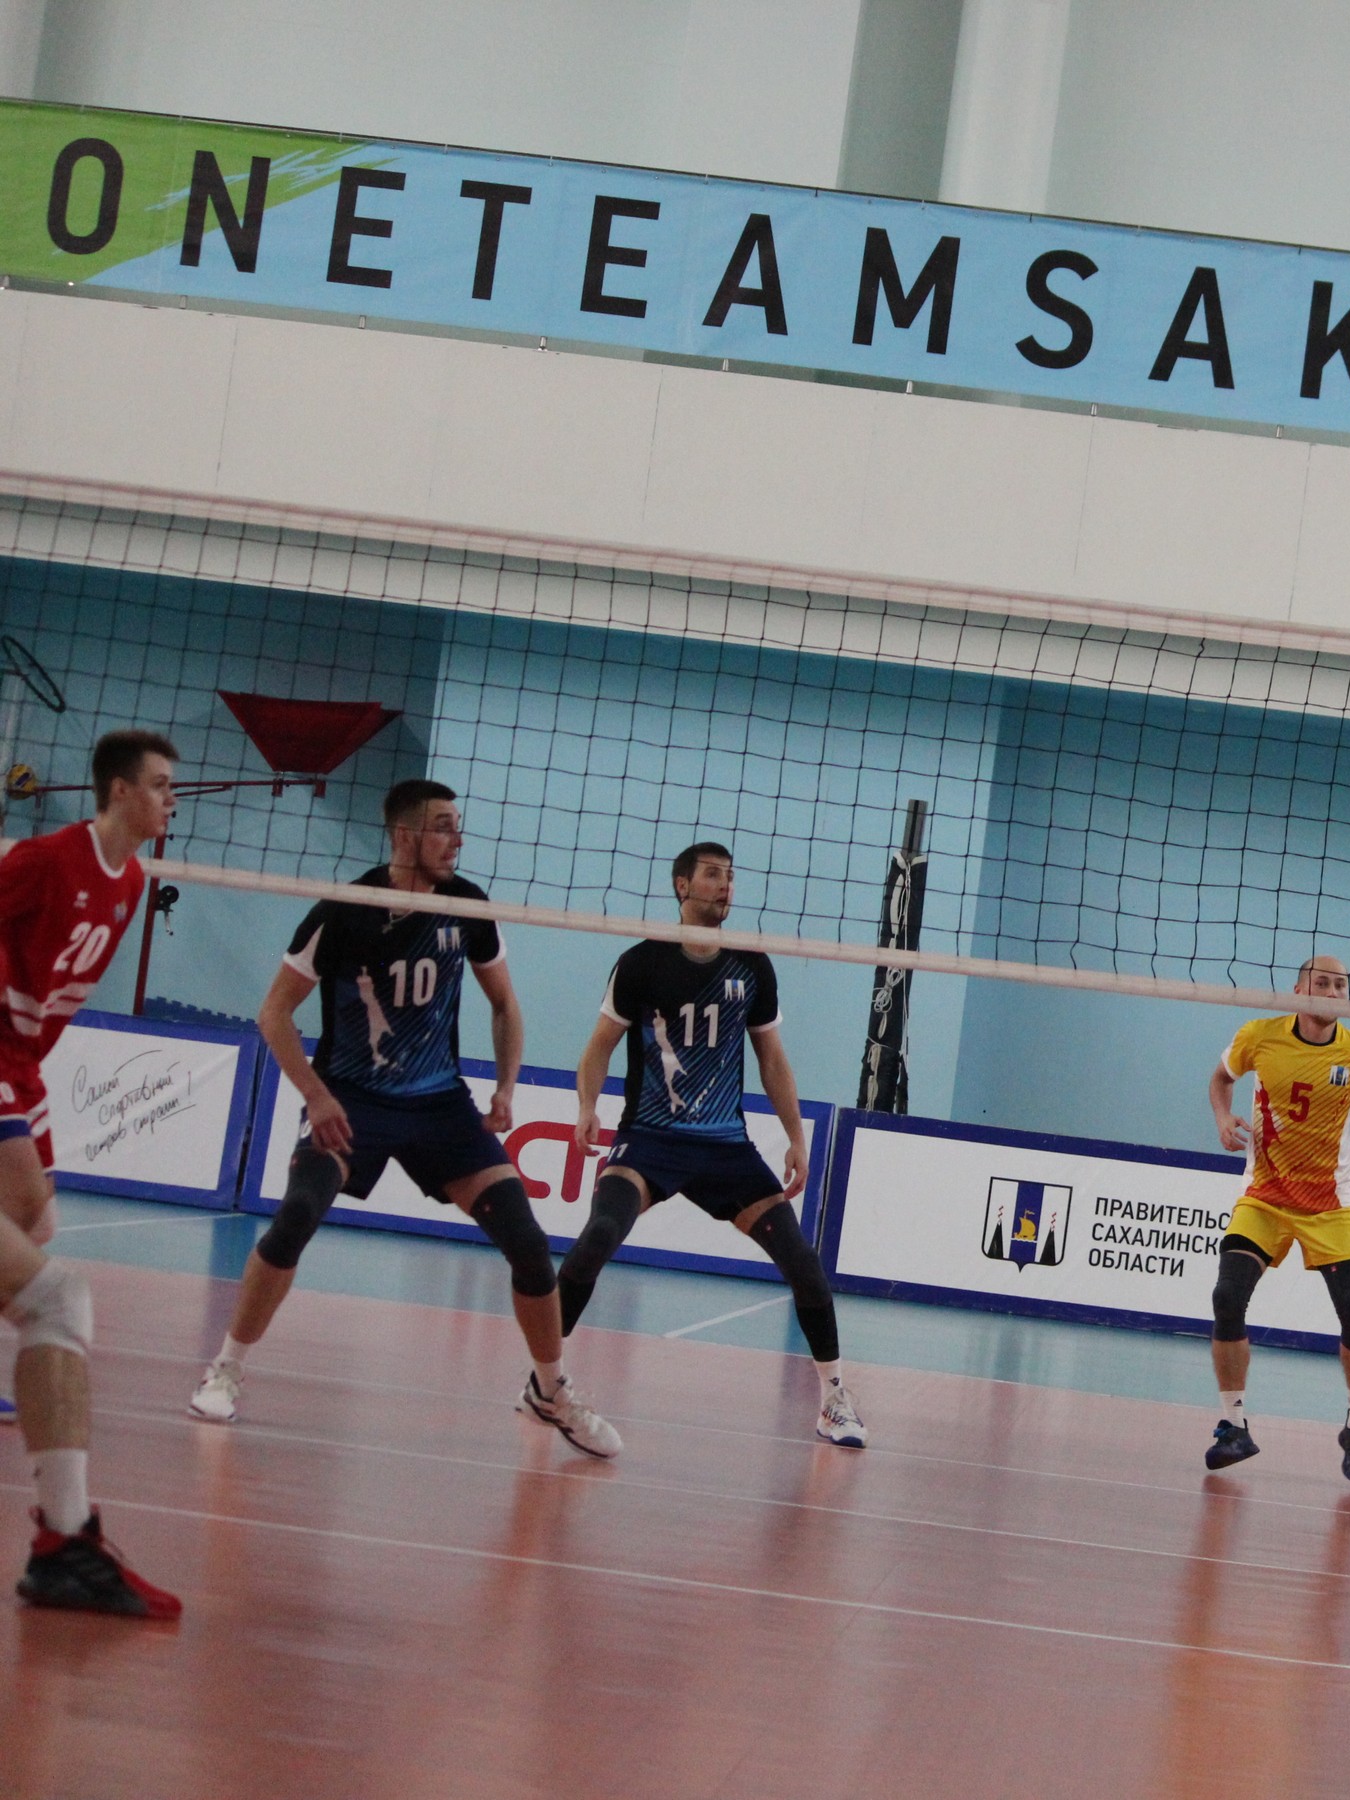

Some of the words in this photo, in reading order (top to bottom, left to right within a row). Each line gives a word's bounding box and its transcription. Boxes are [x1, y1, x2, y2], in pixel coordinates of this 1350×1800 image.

[53, 920, 110, 976] 20
[389, 957, 437, 1008] 10
[679, 1002, 719, 1048] 11
[1287, 1080, 1313, 1123] 5
[1094, 1196, 1231, 1231] ПРАВИТЕЛЬС
[1091, 1222, 1223, 1256] САХАЛИНСК
[1088, 1248, 1184, 1278] ОБЛАСТИ
